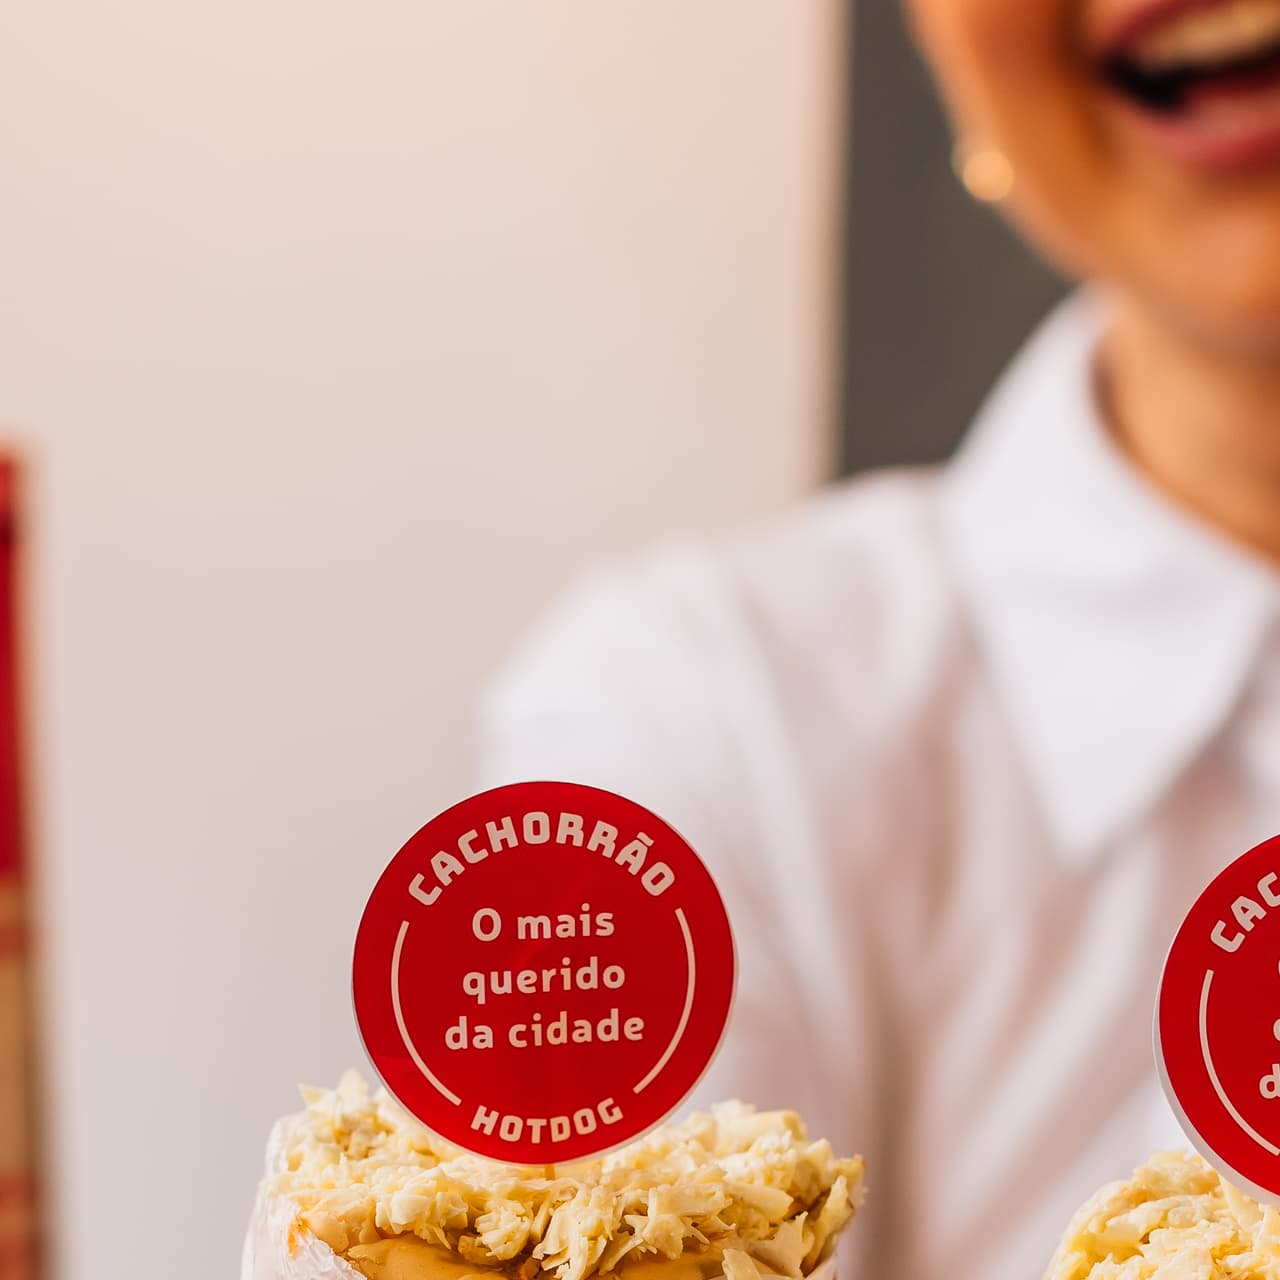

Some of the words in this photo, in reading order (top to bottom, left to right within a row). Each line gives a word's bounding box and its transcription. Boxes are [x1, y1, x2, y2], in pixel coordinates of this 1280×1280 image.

[408, 811, 675, 906] CACHORRÃO
[472, 908, 502, 942] O
[517, 903, 615, 940] mais
[462, 956, 625, 1004] querido
[445, 1016, 494, 1050] da
[509, 1008, 645, 1047] cidade
[471, 1098, 623, 1144] HOTDOG
